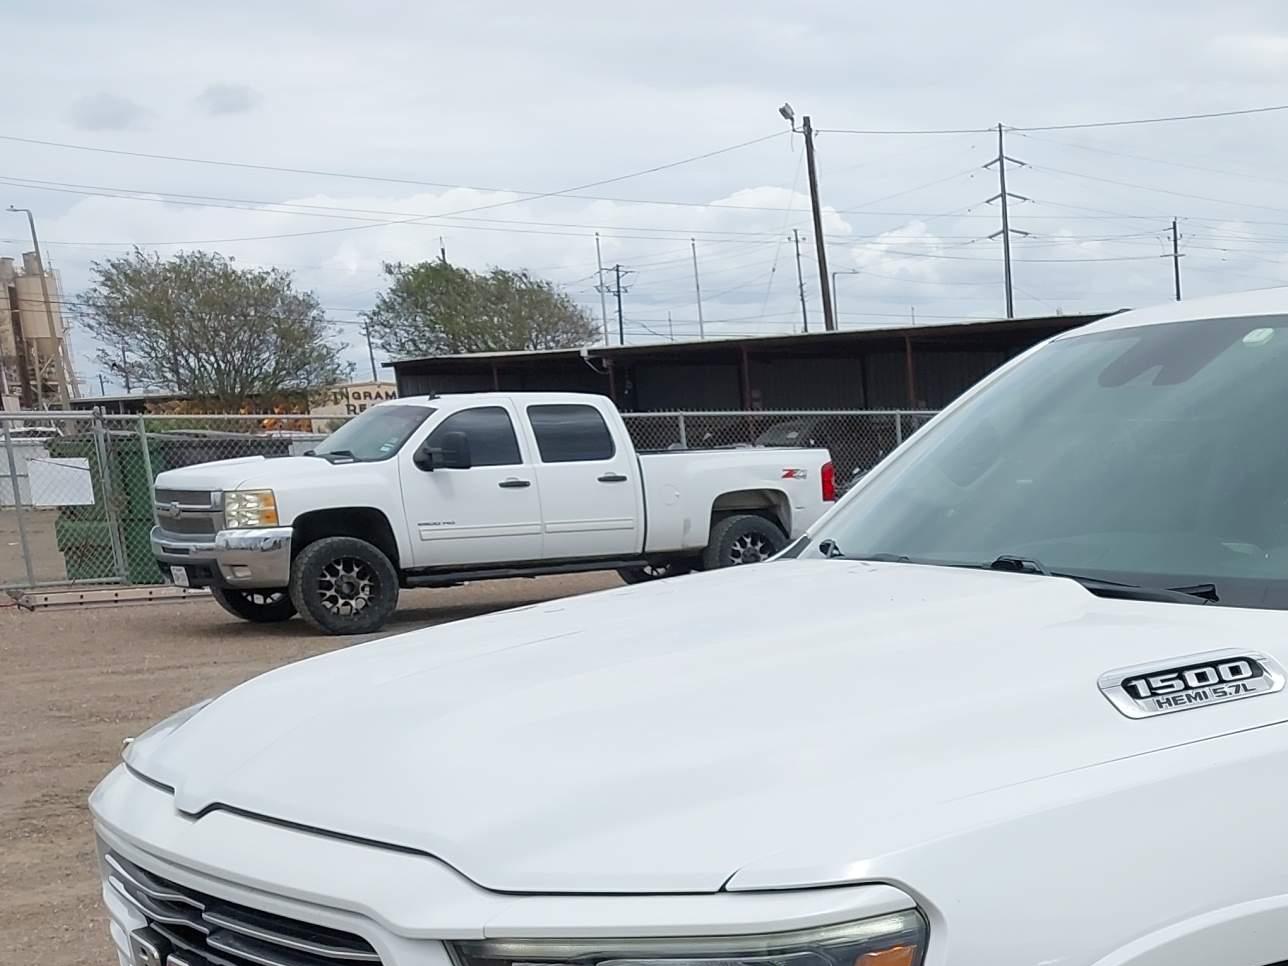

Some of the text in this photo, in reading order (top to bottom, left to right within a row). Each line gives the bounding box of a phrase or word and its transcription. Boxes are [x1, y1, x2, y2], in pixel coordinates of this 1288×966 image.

[333, 390, 397, 400] INGRAM
[1128, 659, 1254, 699] 1500
[1155, 682, 1258, 710] HEMI 5.7L
